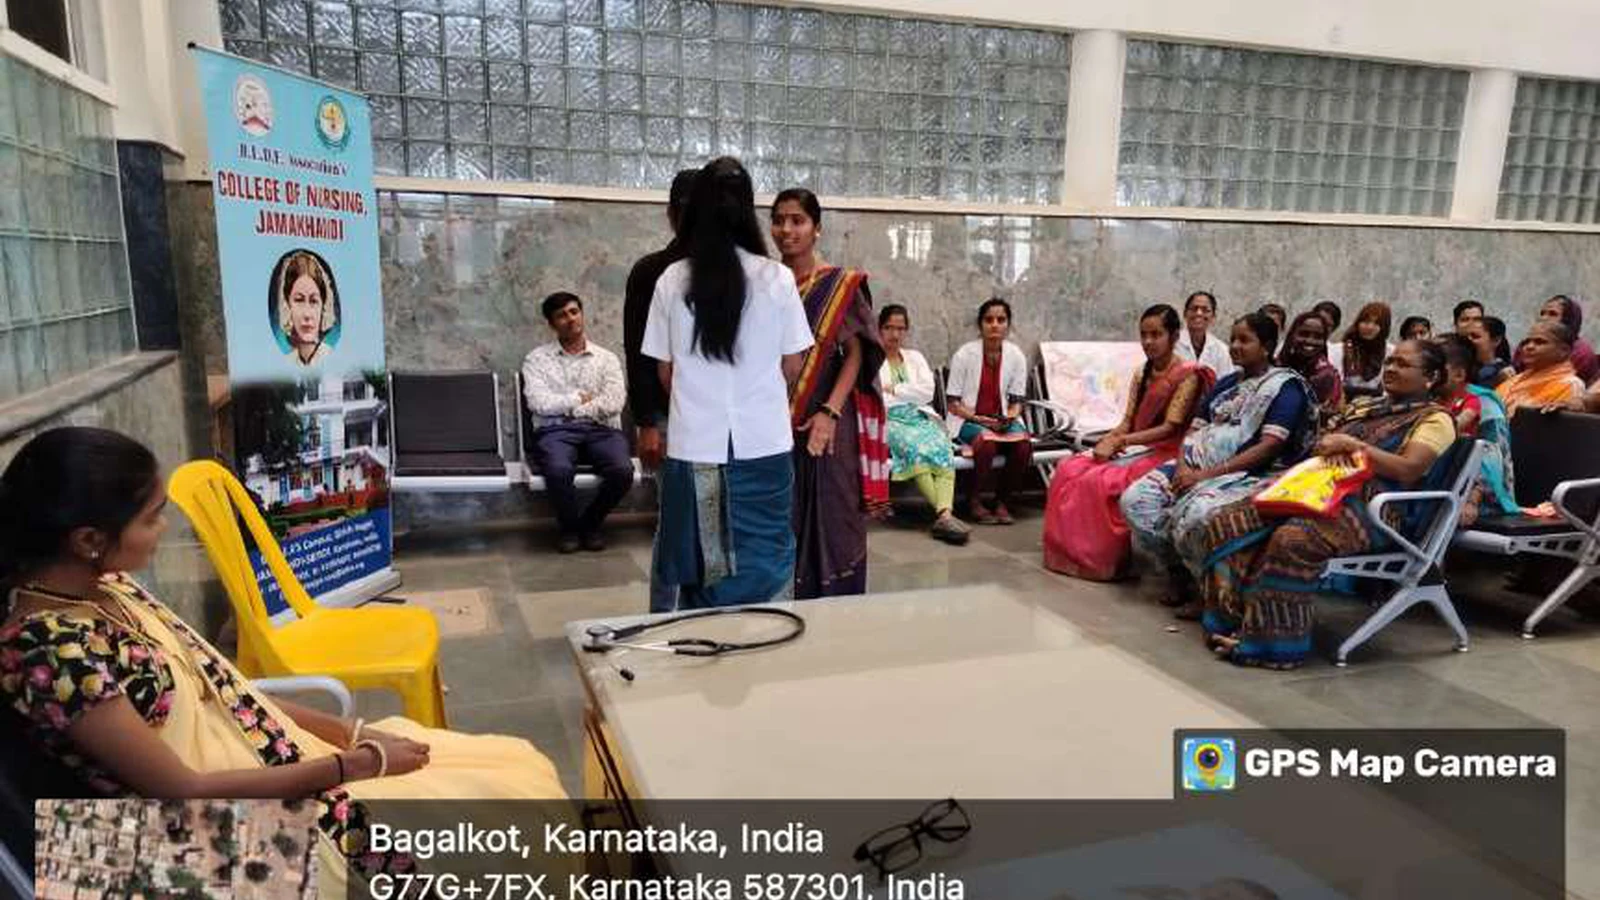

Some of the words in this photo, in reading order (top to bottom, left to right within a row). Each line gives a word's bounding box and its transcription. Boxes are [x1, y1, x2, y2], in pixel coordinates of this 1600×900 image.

[218, 171, 280, 202] COLLEGE
[285, 180, 301, 206] OF
[306, 185, 368, 216] NURSING,
